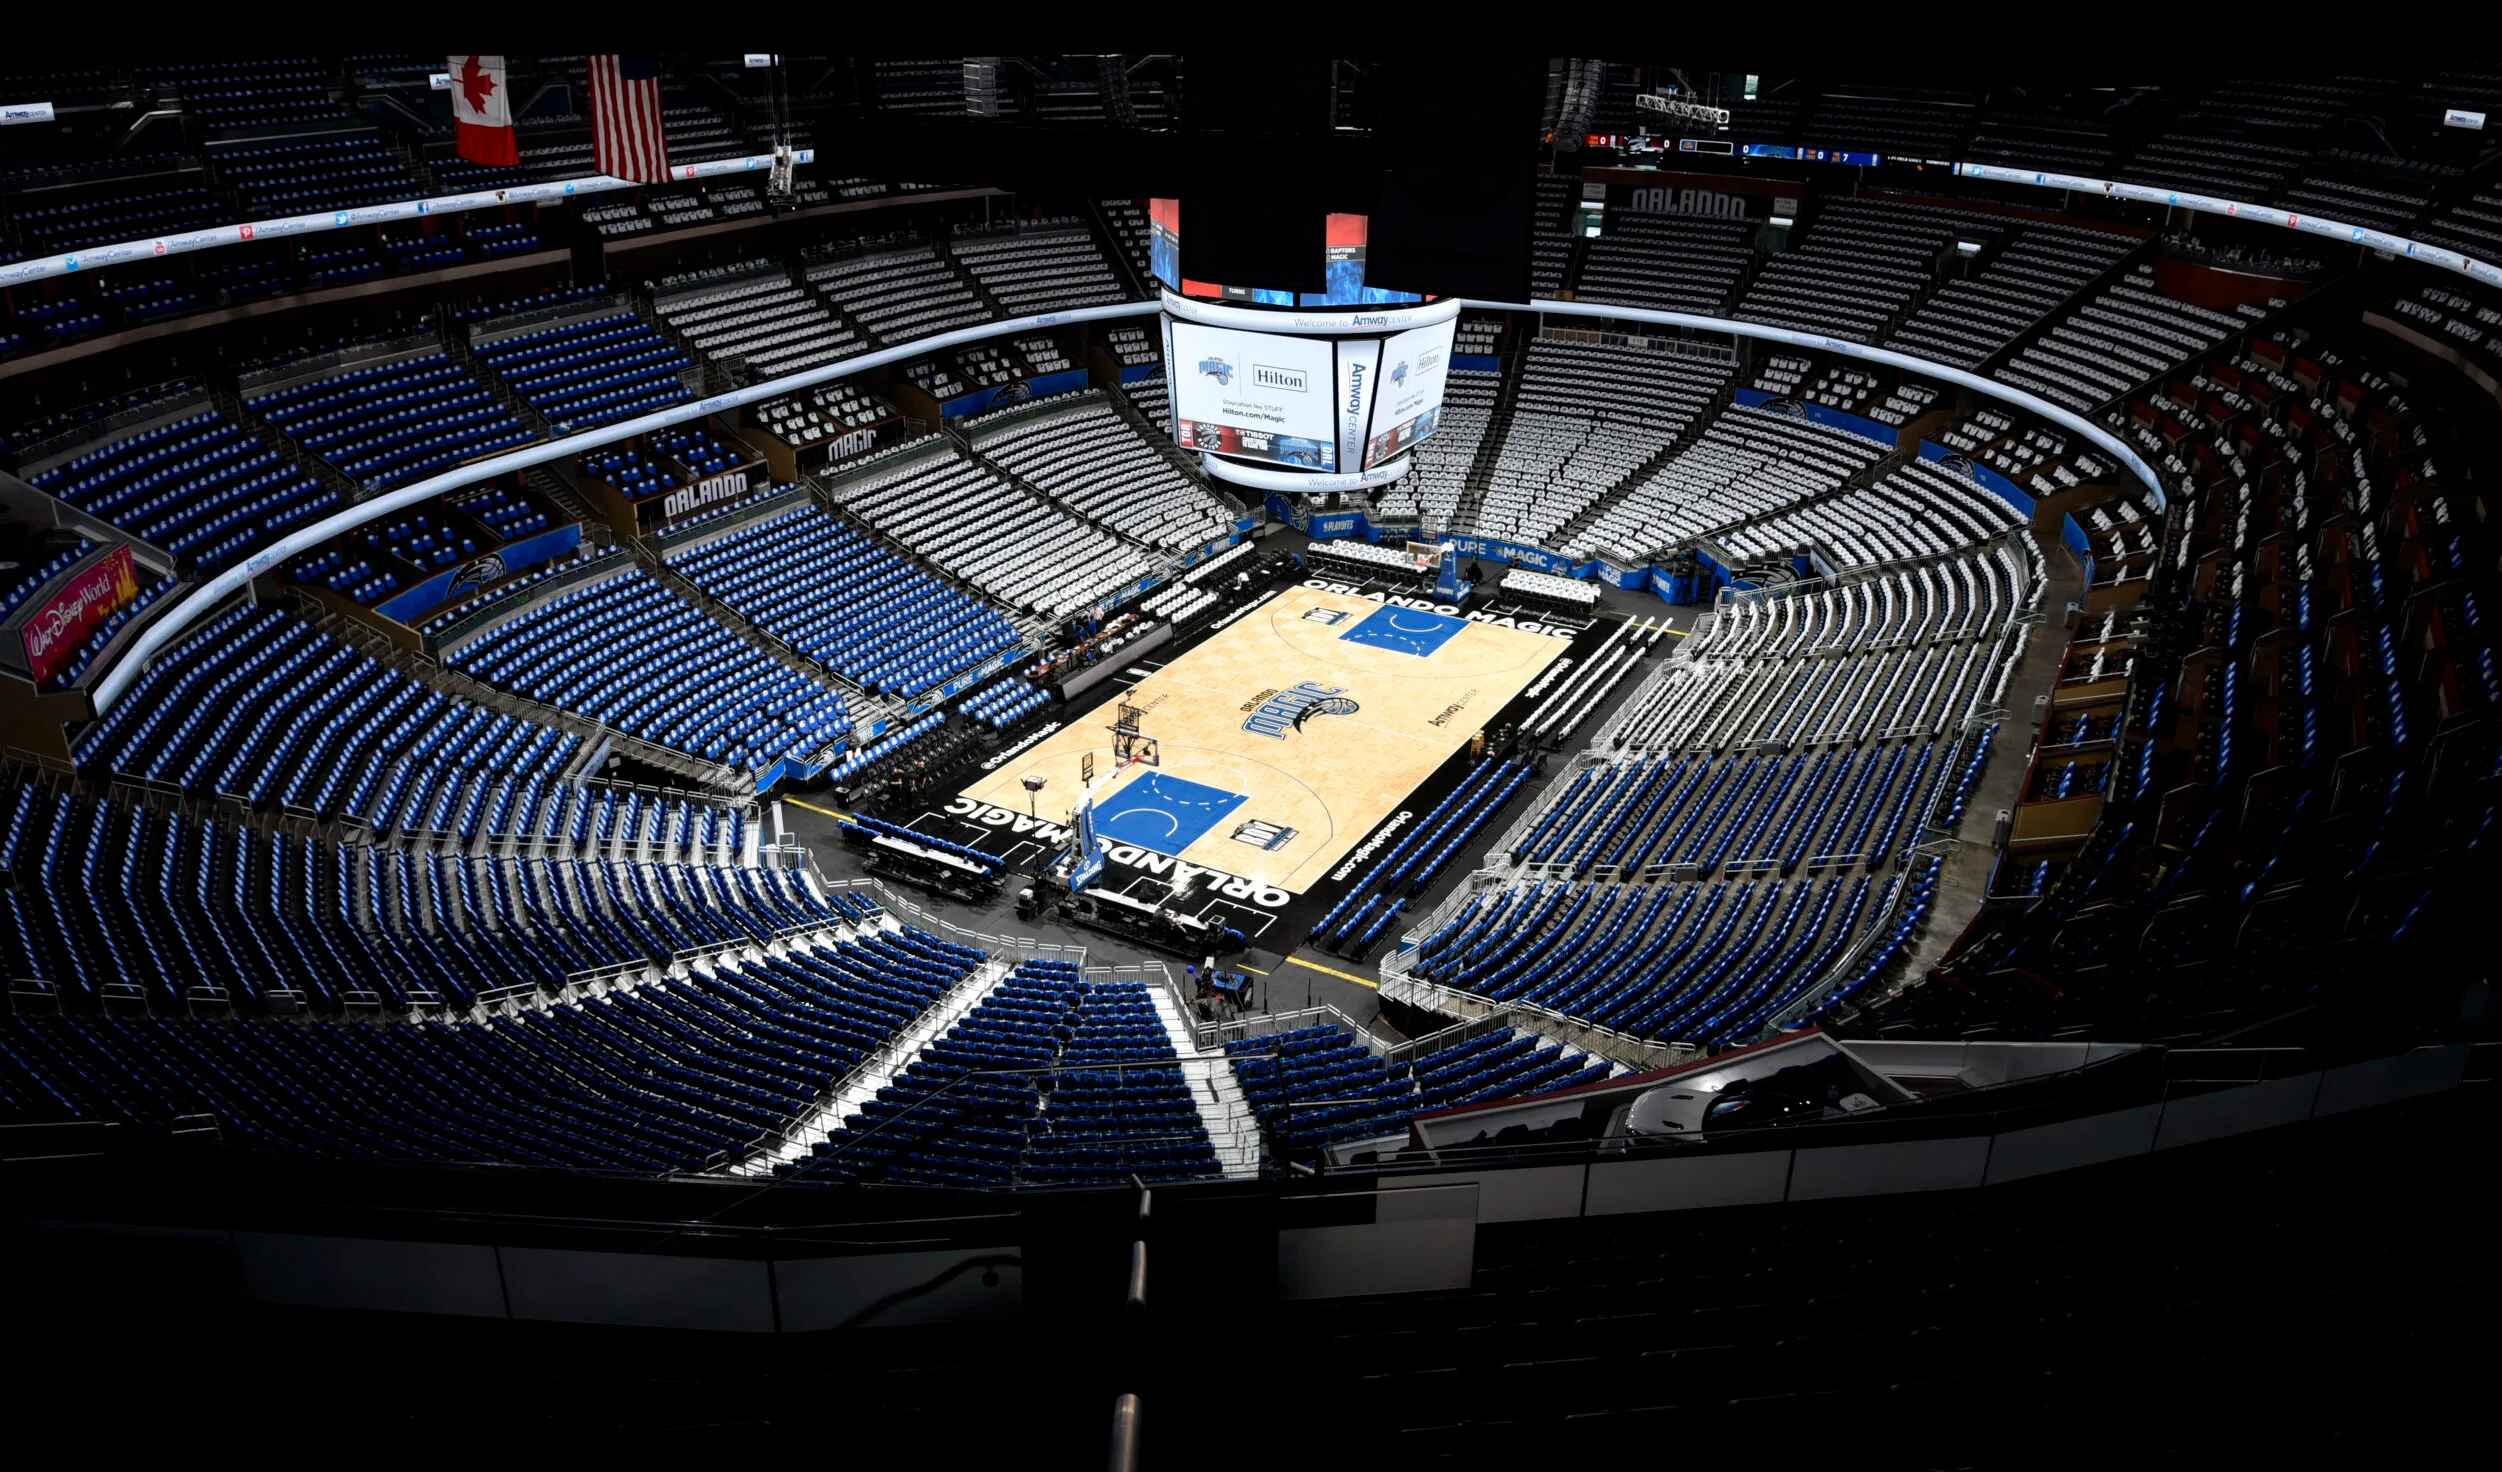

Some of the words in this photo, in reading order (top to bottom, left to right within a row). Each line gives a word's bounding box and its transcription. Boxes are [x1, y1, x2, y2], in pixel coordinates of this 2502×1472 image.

[1664, 140, 1670, 148] 0
[1743, 145, 1749, 154] 0
[1817, 151, 1824, 160] 0
[1842, 153, 1849, 162] 7
[1632, 188, 1745, 219] ORLANDO
[1295, 318, 1337, 328] Welcome
[1352, 315, 1389, 326] Amway
[1388, 315, 1413, 324] CENTER
[1257, 368, 1303, 388] Hilton
[1347, 363, 1366, 415] Amway
[1222, 407, 1285, 424] Hilton.com/Magic
[828, 429, 877, 461] MAGIC
[1180, 423, 1192, 443] TOR
[1347, 415, 1357, 455] CENTER
[1322, 446, 1333, 466] ORL
[1308, 478, 1346, 487] Welcome
[1360, 469, 1388, 482] Amway
[664, 473, 747, 517] ORLANDO
[1450, 539, 1487, 555] PURE
[1503, 546, 1547, 567] MAGIC
[80, 573, 112, 605] World
[1303, 579, 1460, 615] ORLANDO
[1465, 610, 1577, 640] MAGIC
[953, 673, 973, 690] PURE
[981, 656, 1005, 677] MAGIC
[1240, 688, 1279, 713] ORLANDO
[1242, 680, 1348, 740] MAGIC
[1428, 703, 1464, 728] Amway
[1459, 688, 1479, 706] CENTER
[980, 721, 1061, 769] @OrlandoMagic
[944, 797, 1073, 844] MAGIC
[1331, 810, 1413, 881] OrlandoMagic.com
[1076, 860, 1102, 886] SPALDING
